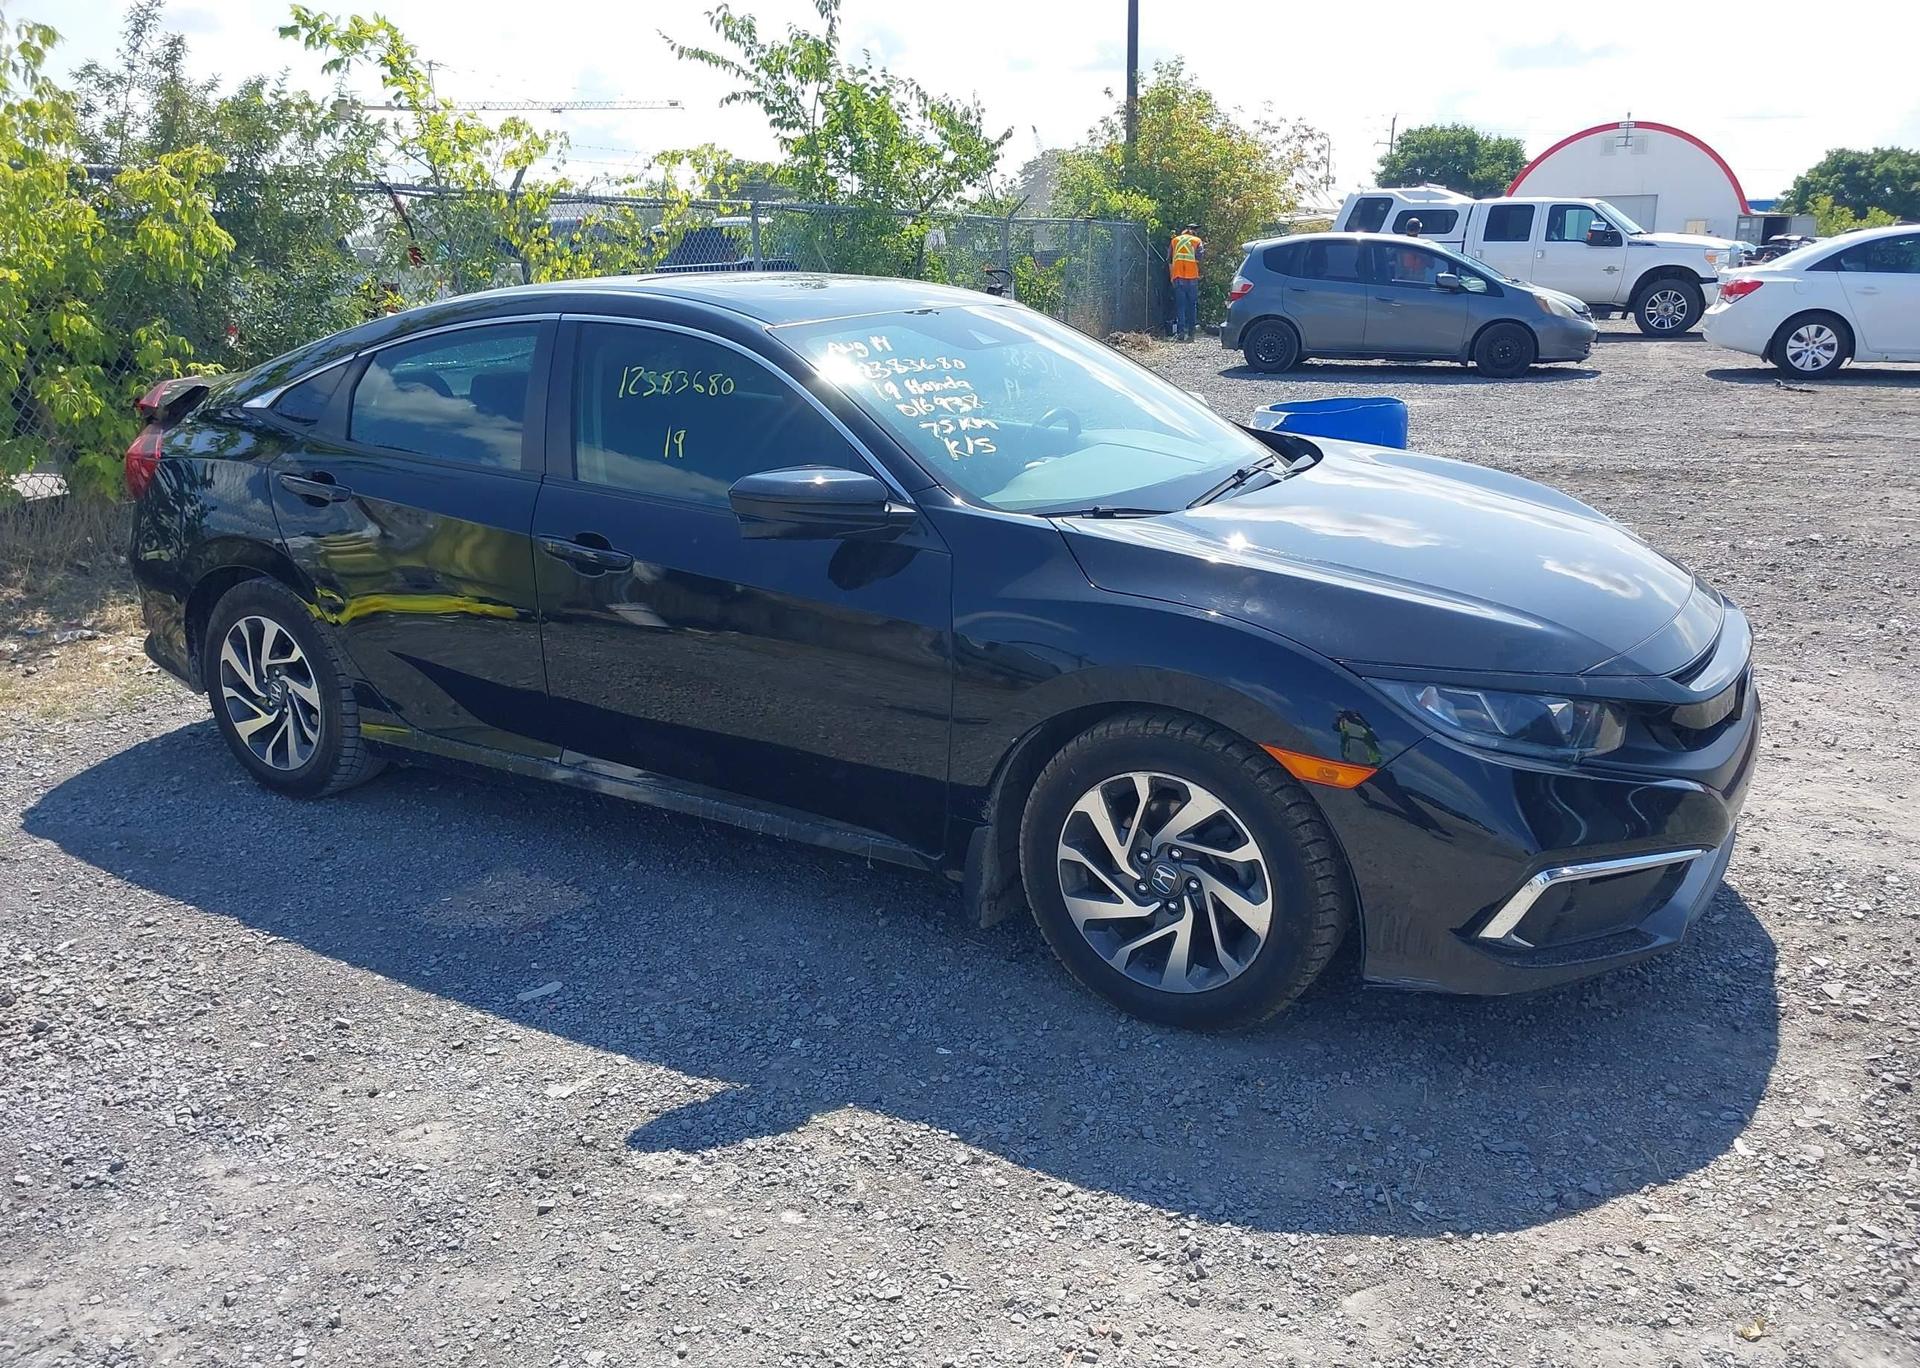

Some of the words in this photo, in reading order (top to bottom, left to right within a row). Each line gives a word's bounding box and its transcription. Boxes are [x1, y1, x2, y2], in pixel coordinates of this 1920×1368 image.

[618, 366, 735, 398] 12383680
[903, 375, 975, 395] Honda
[664, 425, 686, 458] 19
